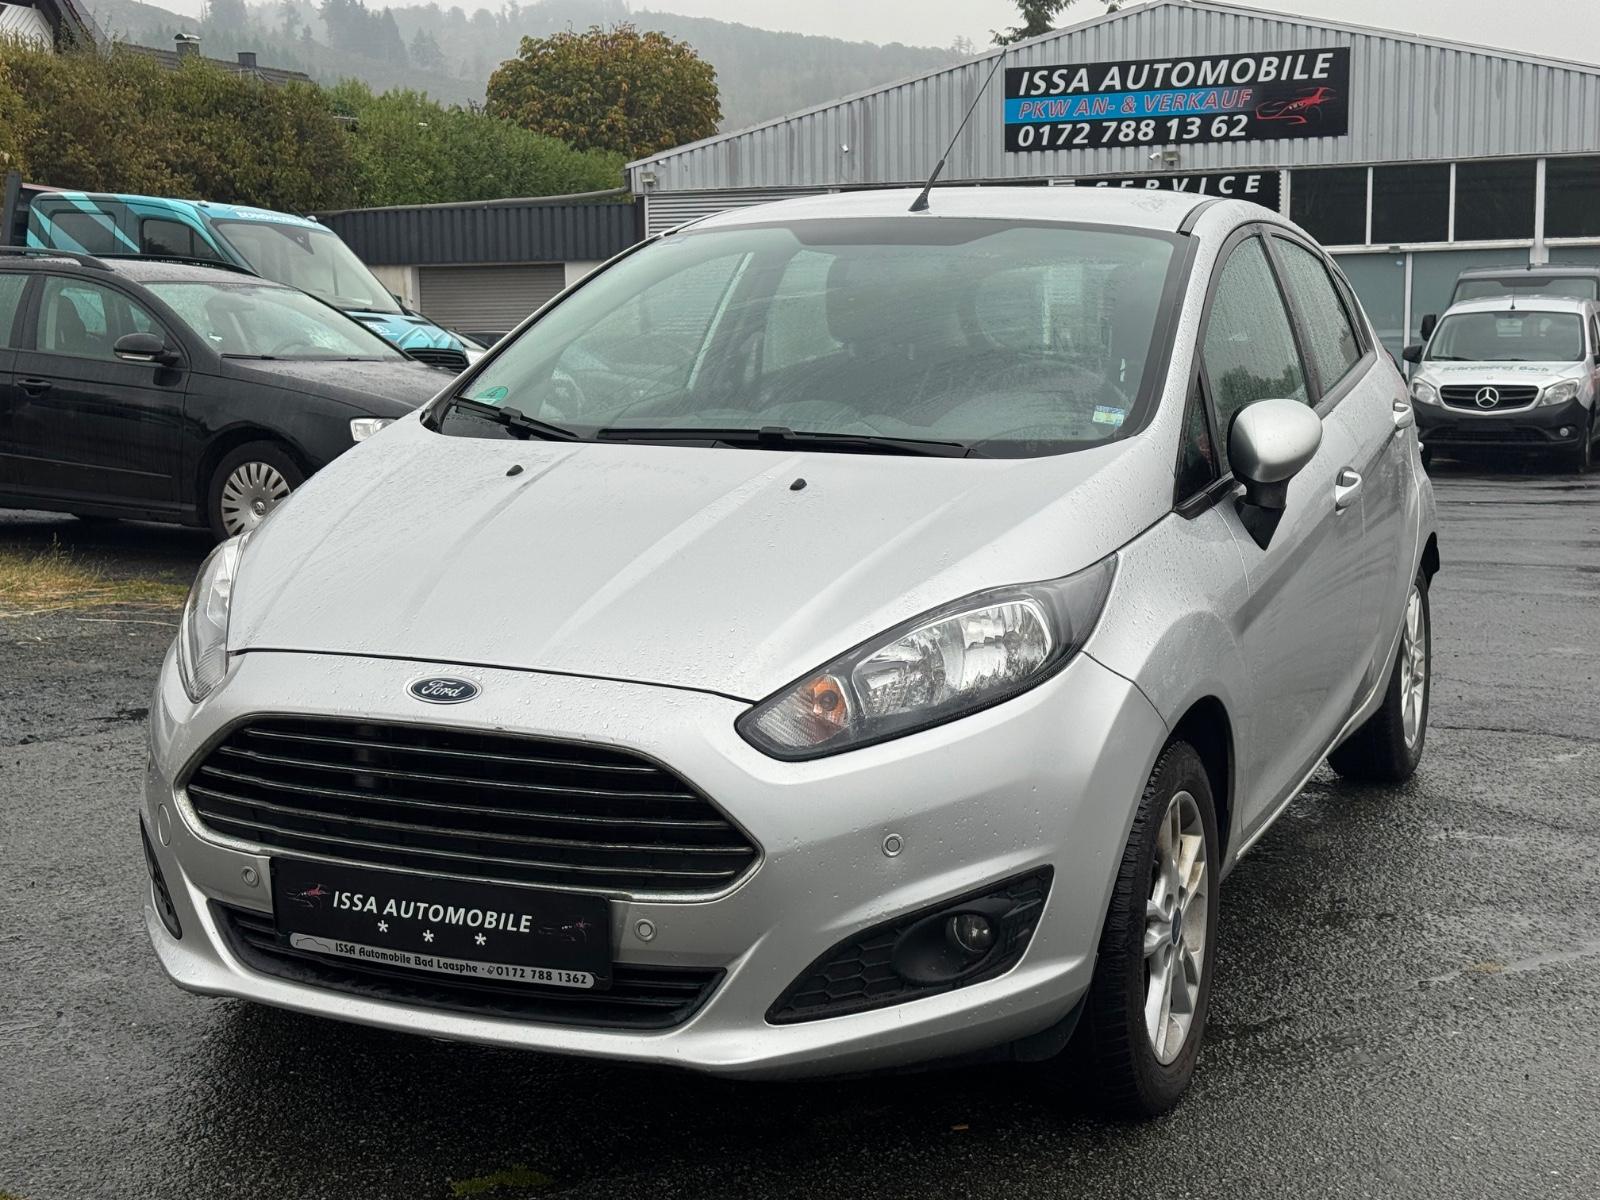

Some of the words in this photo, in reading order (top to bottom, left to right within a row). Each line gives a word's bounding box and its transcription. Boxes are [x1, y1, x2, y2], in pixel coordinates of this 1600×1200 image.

[1018, 67, 1090, 96] ISSA
[1098, 52, 1334, 92] AUTOMOBILE
[1018, 98, 1070, 120] PKW
[1072, 96, 1116, 117] AN-
[1121, 95, 1136, 114] &
[1144, 88, 1253, 112] VERKAUF
[1017, 122, 1091, 147] 0172
[1100, 119, 1156, 143] 788
[1166, 117, 1202, 140] 13
[1210, 114, 1248, 138] 62
[421, 680, 465, 697] Ford
[333, 891, 377, 914] ISSA
[382, 898, 532, 933] AUTOMOBILE
[335, 942, 356, 955] ISSA
[359, 946, 411, 964] Automobile
[414, 955, 434, 968] Bad
[437, 959, 478, 974] Laasphe
[496, 966, 526, 978] 0172
[530, 969, 553, 981] 788
[558, 972, 587, 984] 1362
